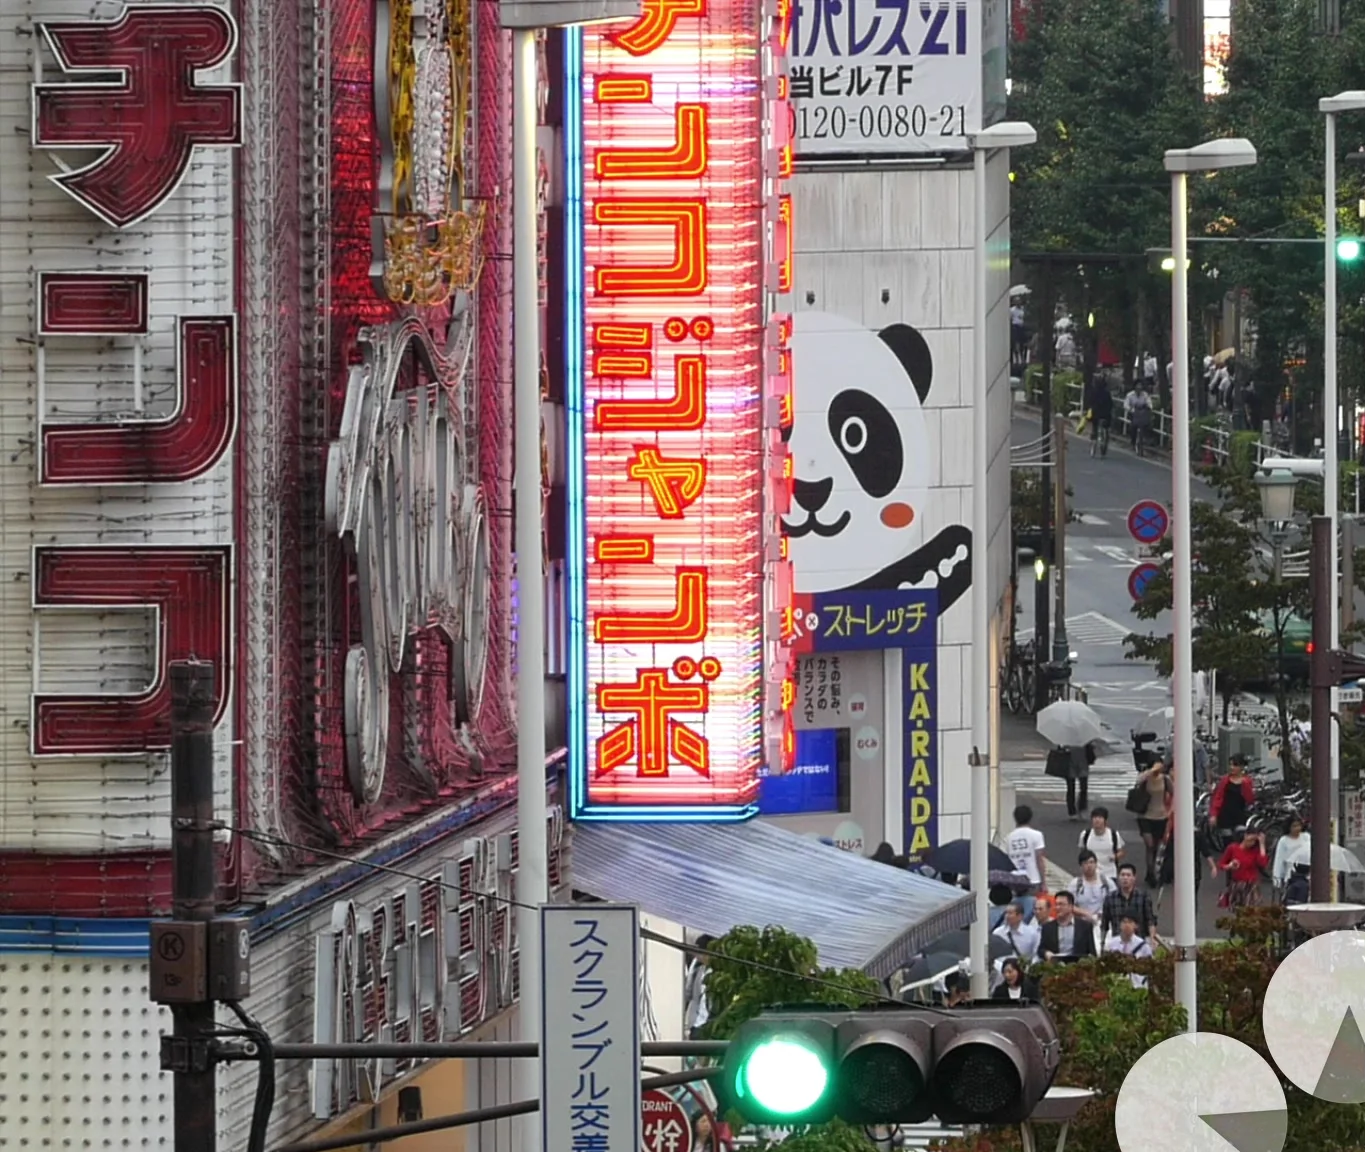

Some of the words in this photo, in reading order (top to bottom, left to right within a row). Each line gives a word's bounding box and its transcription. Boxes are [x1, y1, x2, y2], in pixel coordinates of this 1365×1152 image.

[790, 64, 913, 98] 当ビル7F
[822, 602, 928, 638] ストレッチ
